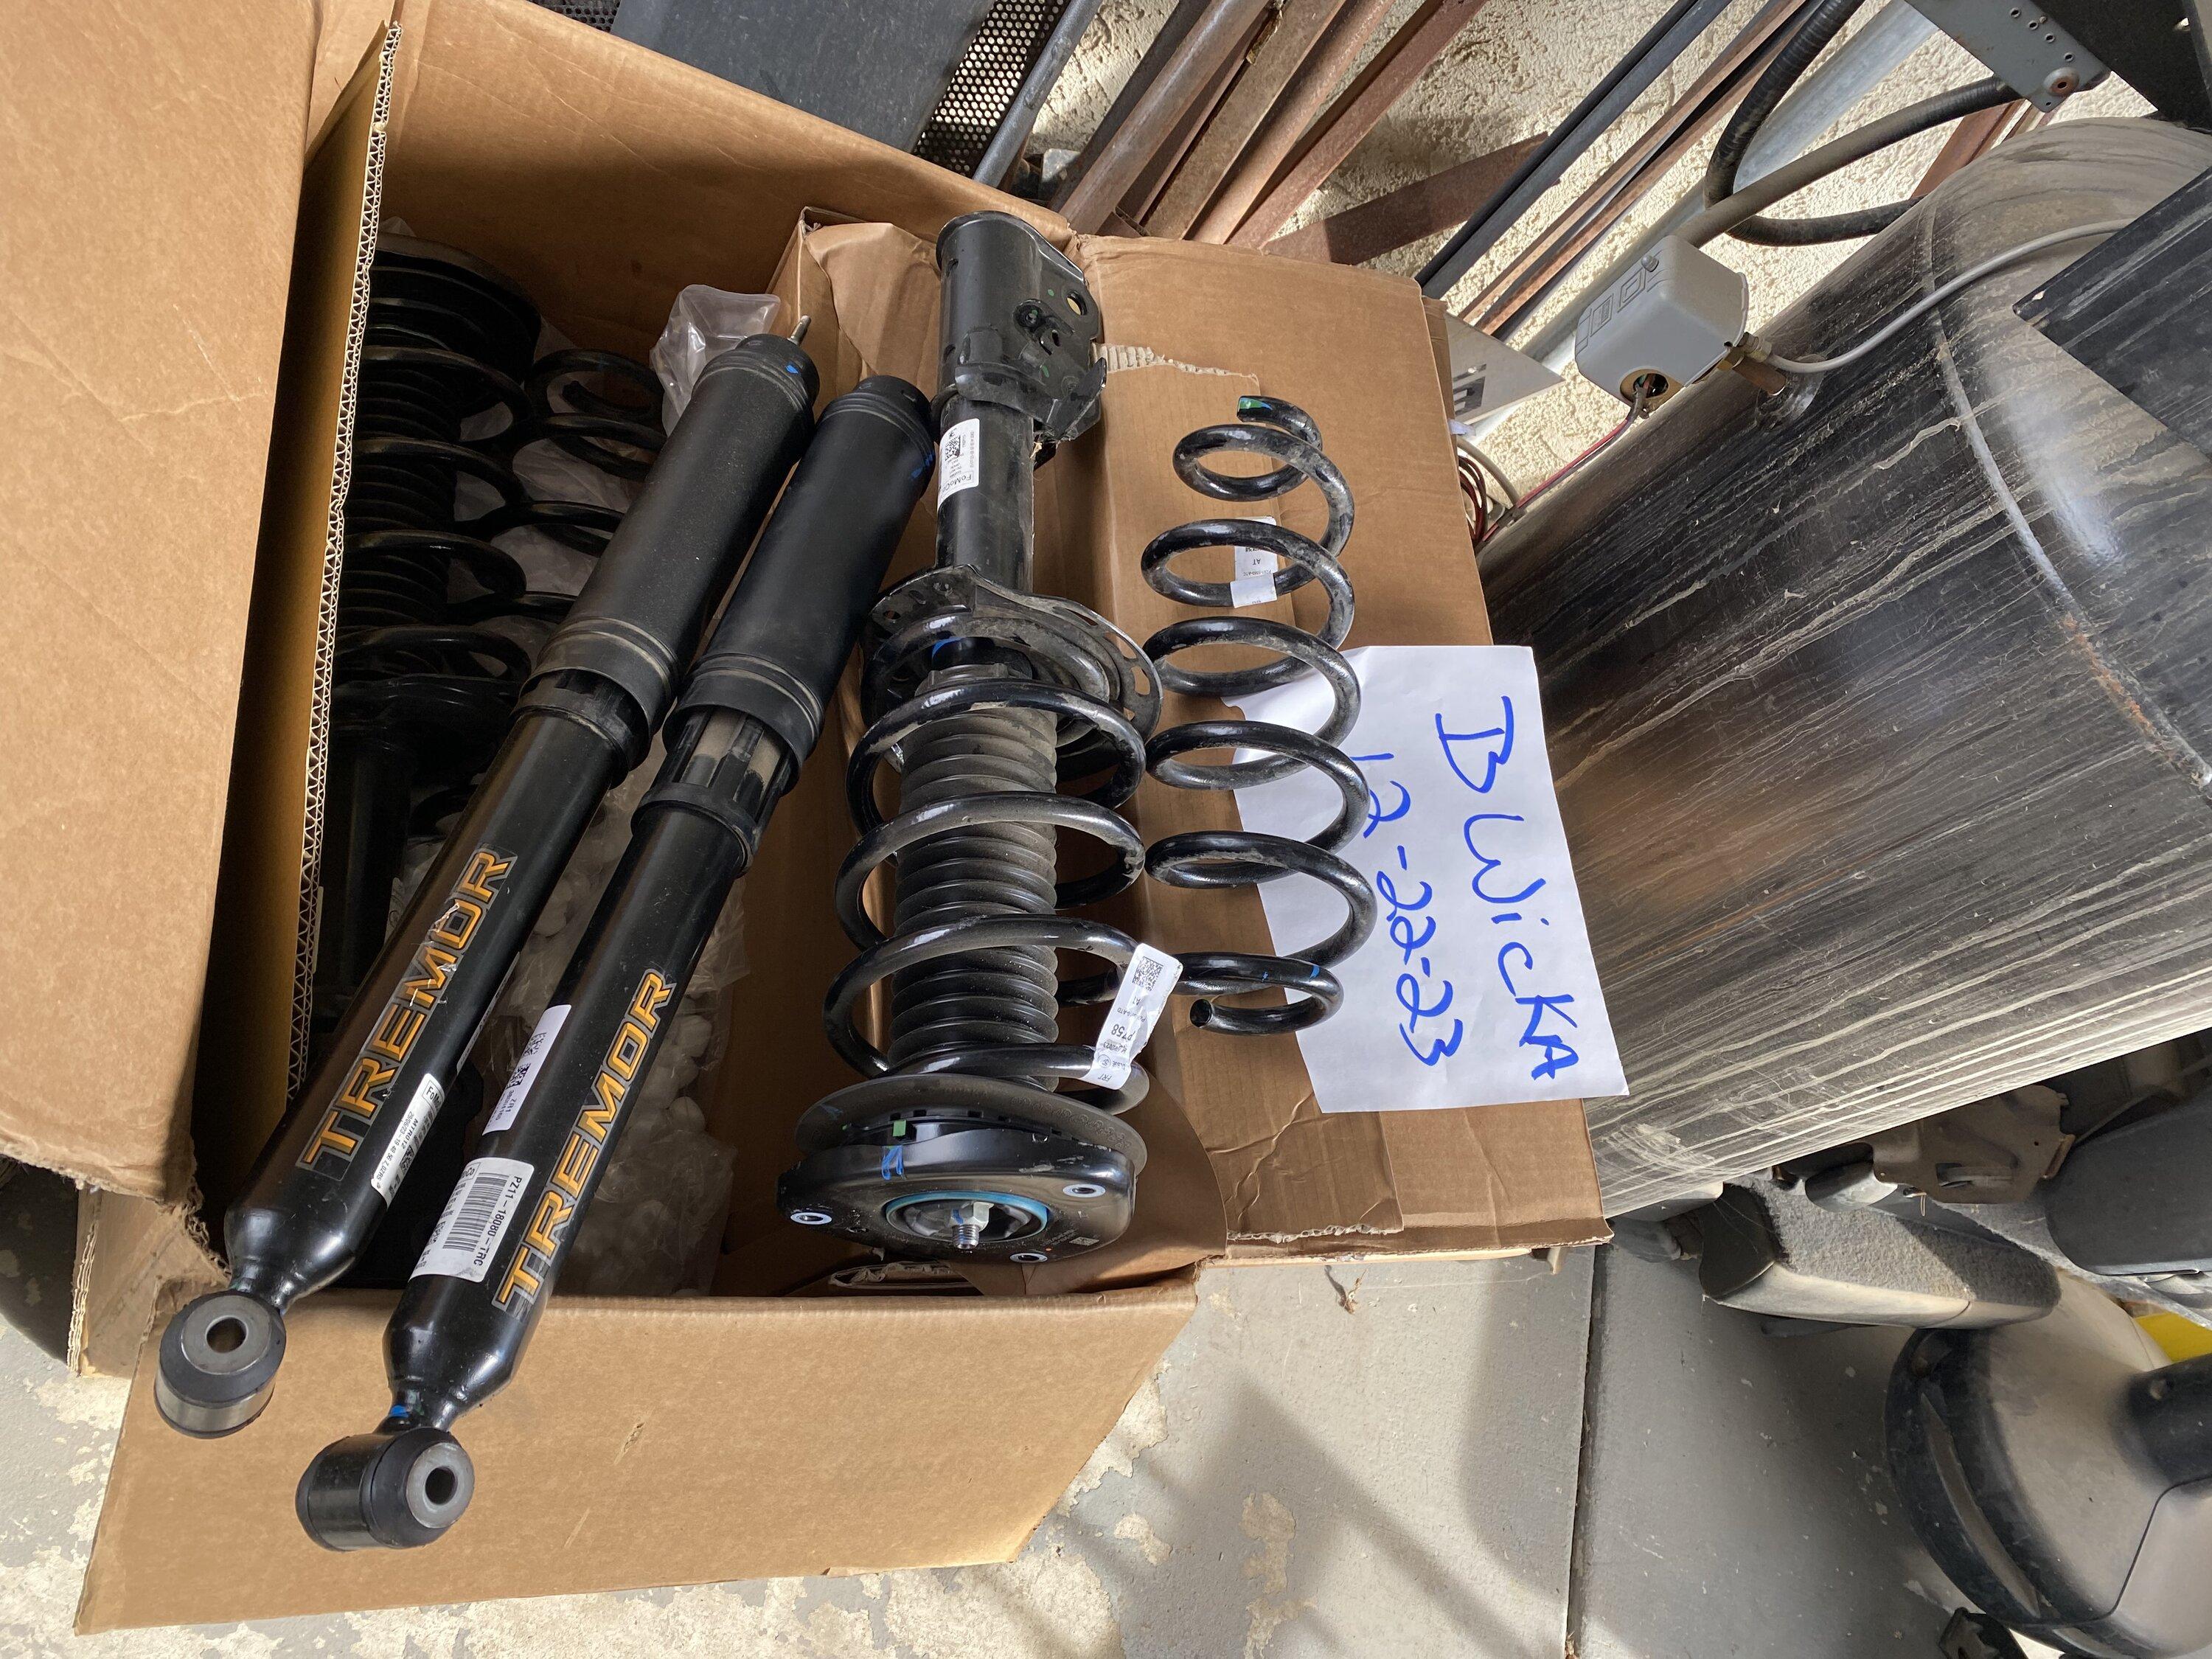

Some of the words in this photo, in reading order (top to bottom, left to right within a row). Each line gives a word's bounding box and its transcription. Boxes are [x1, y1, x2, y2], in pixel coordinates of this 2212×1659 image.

[299, 847, 515, 1172] TREMOR
[495, 969, 676, 1311] TREMOR
[1098, 1074, 1113, 1082] FRT
